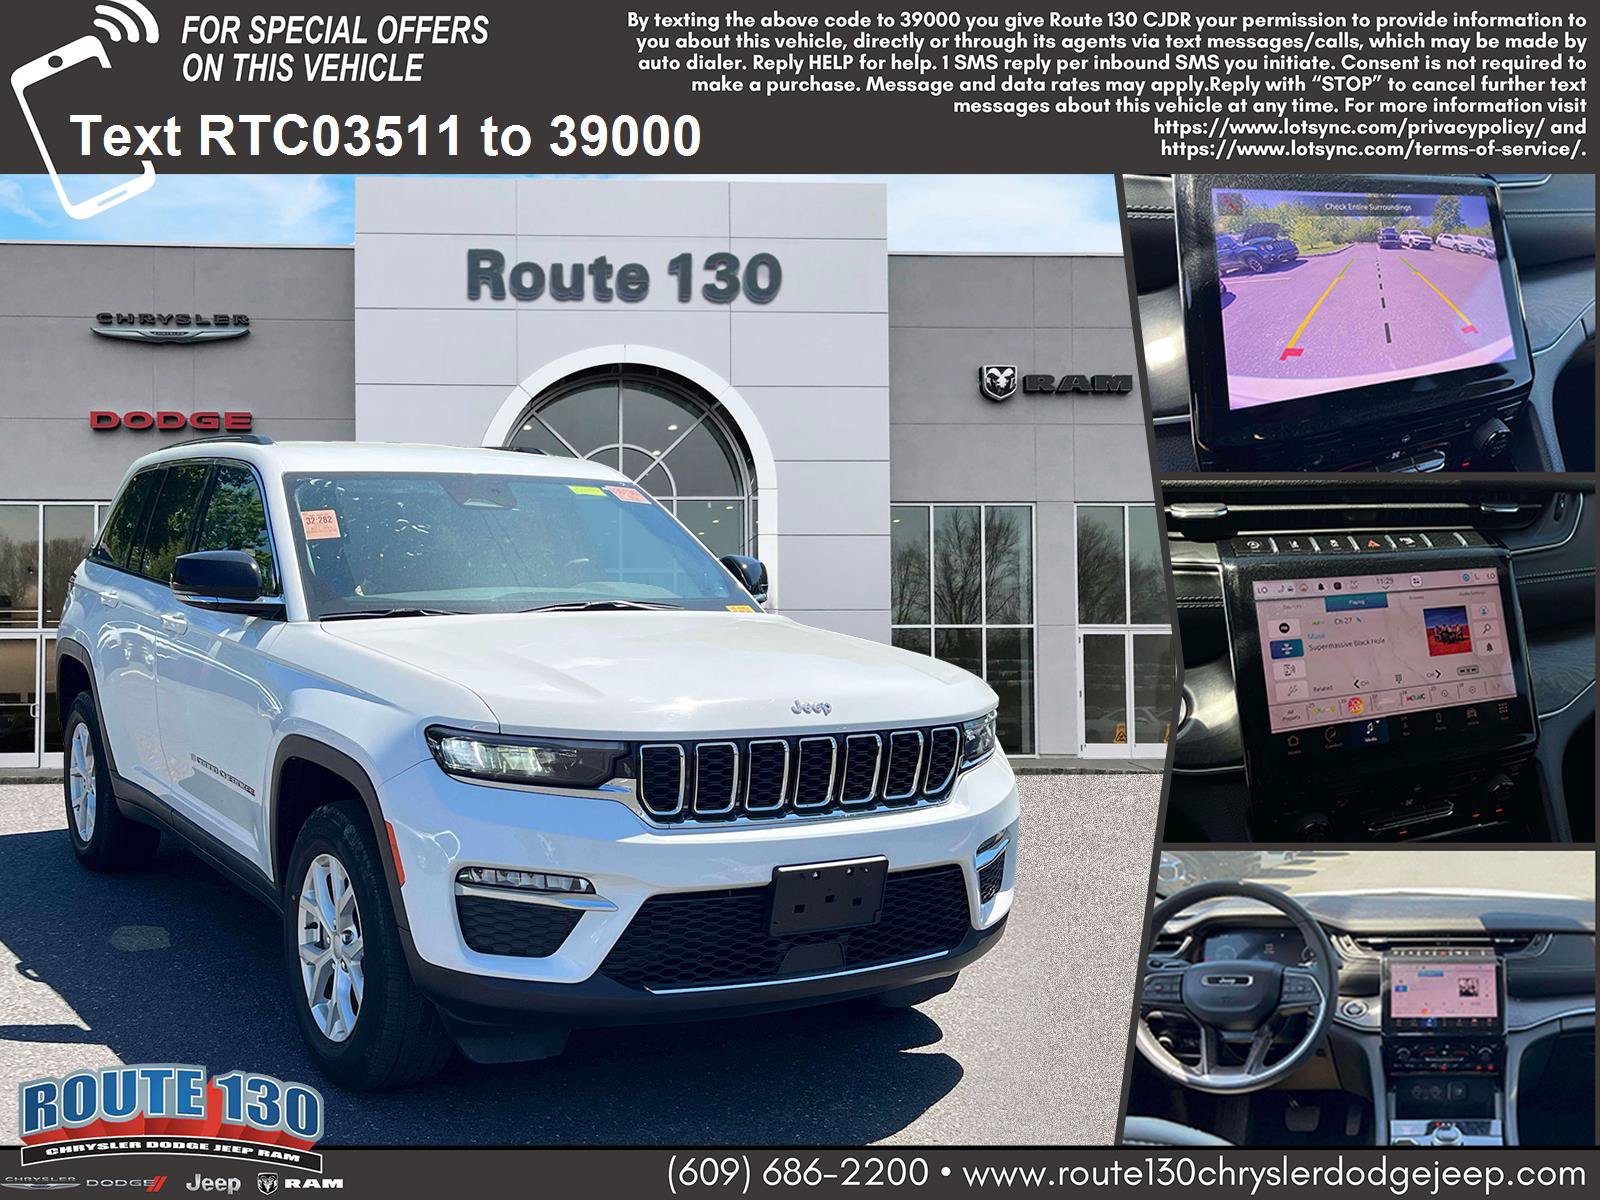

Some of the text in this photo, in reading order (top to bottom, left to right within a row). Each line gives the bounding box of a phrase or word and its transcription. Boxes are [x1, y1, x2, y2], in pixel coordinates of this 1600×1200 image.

[1324, 202, 1412, 213] Check Entire Surroundings
[467, 248, 783, 304] Route 130
[96, 312, 250, 326] CHRYSLER
[1022, 374, 1133, 394] RAM
[89, 411, 253, 431] DODGE
[791, 699, 832, 717] Jeep
